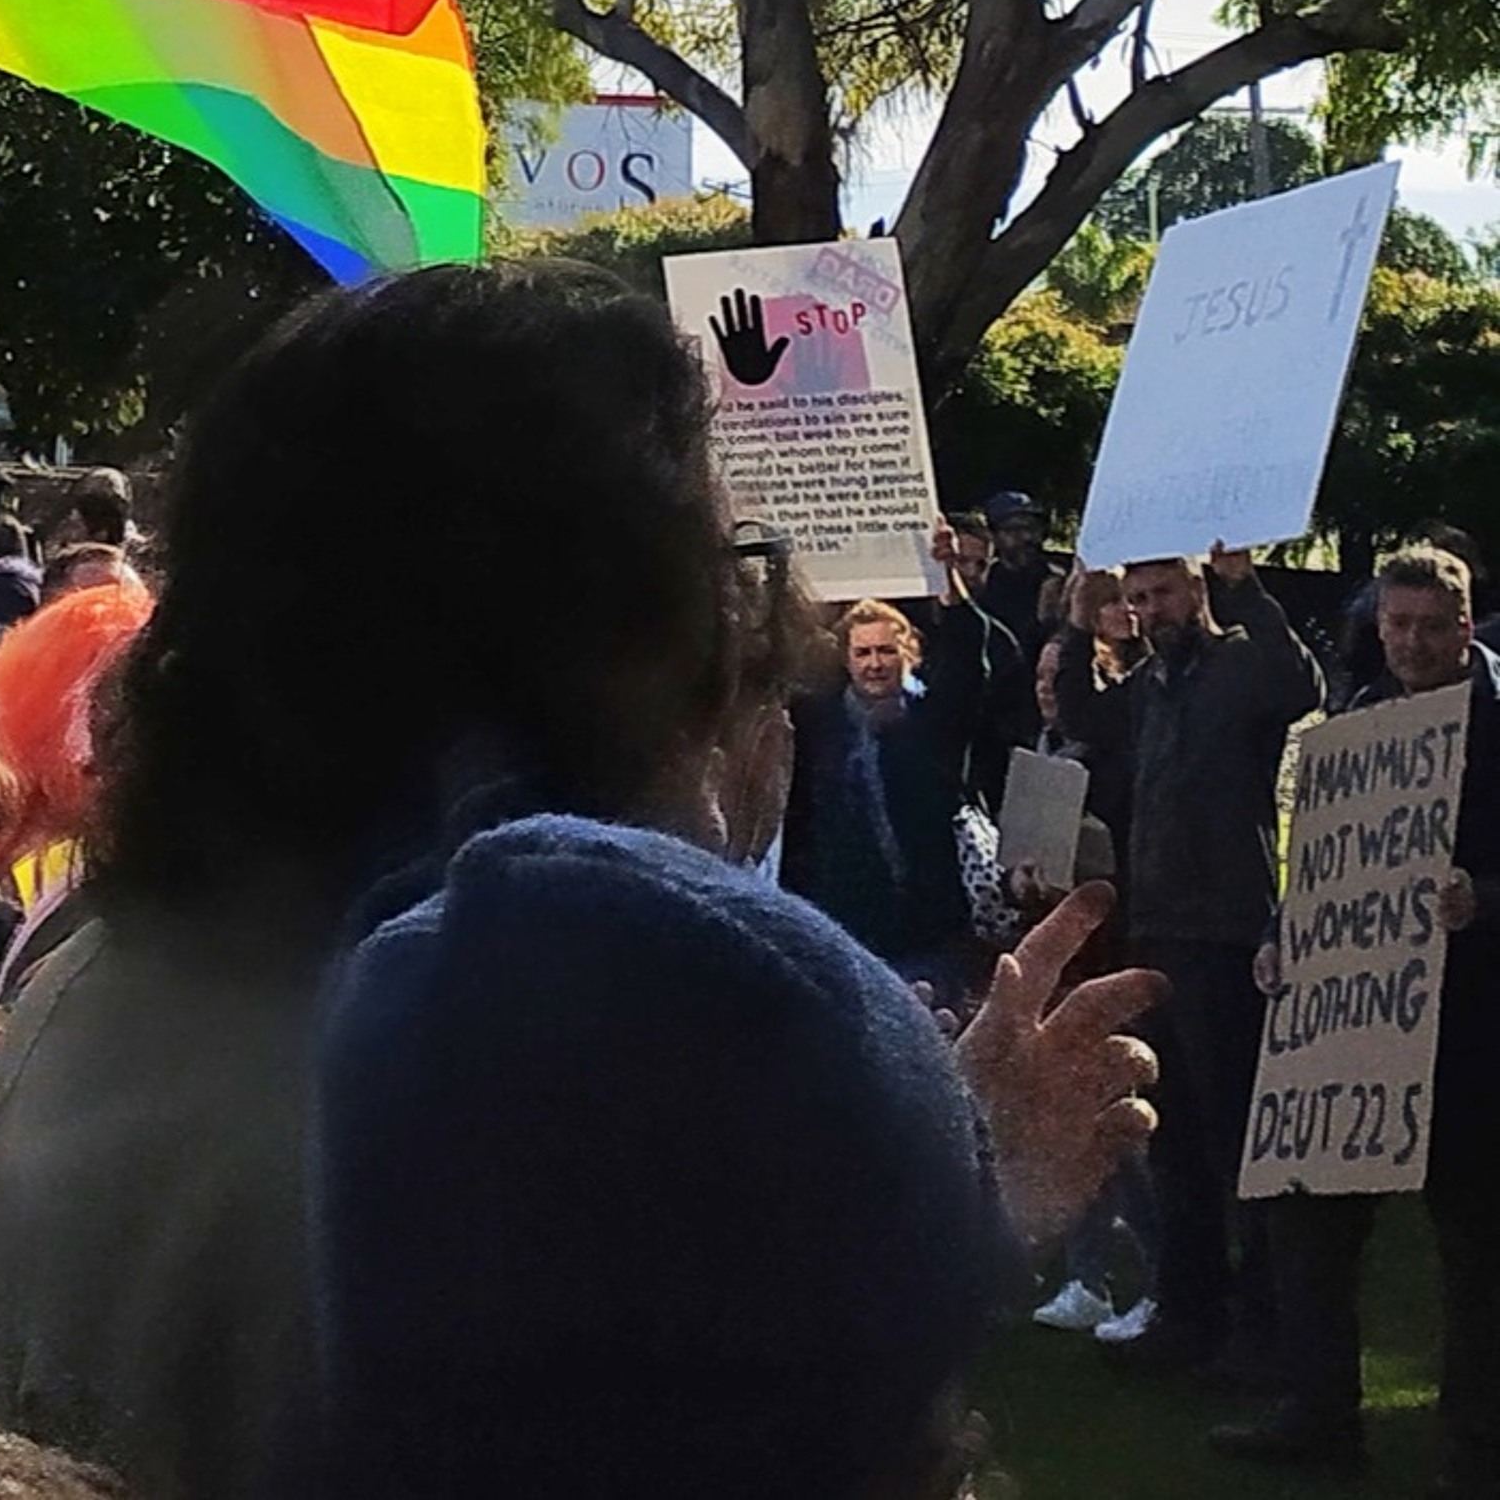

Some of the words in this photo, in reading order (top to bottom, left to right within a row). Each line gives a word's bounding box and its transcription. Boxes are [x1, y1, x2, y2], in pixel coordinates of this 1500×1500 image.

[1174, 265, 1295, 344] JESUS
[795, 301, 867, 336] STOP
[737, 399, 755, 412] he
[759, 396, 790, 410] said
[792, 396, 809, 409] to
[812, 395, 834, 407] his
[804, 413, 821, 426] to
[823, 411, 847, 425] sin
[849, 412, 873, 423] are
[876, 410, 910, 422] sure
[773, 430, 800, 442] but
[802, 428, 833, 441] woe
[835, 426, 852, 439] to
[853, 426, 879, 437] the
[882, 425, 910, 436] one
[779, 445, 823, 459] whom
[825, 443, 857, 458] they
[775, 463, 795, 477] be
[798, 459, 840, 475] better
[844, 458, 865, 472] for
[869, 457, 898, 470] him
[900, 455, 911, 469] if
[791, 477, 827, 490] were
[829, 475, 869, 490] hung
[872, 471, 926, 486] around
[772, 491, 801, 505] and
[803, 490, 822, 503] he
[825, 488, 861, 502] were
[864, 485, 896, 501] cast
[898, 484, 929, 499] into
[777, 508, 810, 522] than
[813, 505, 843, 520] that
[845, 504, 865, 518] he
[868, 500, 920, 516] should
[794, 523, 809, 538] of
[811, 521, 853, 536] these
[855, 519, 889, 534] little
[892, 520, 930, 534] ones
[1371, 722, 1460, 792] MUST
[1299, 824, 1353, 891] NOT
[1357, 798, 1452, 869] WEAR
[1268, 958, 1429, 1054] CLOTHING
[1252, 1084, 1344, 1161] DEUT
[1341, 1083, 1386, 1160] 22
